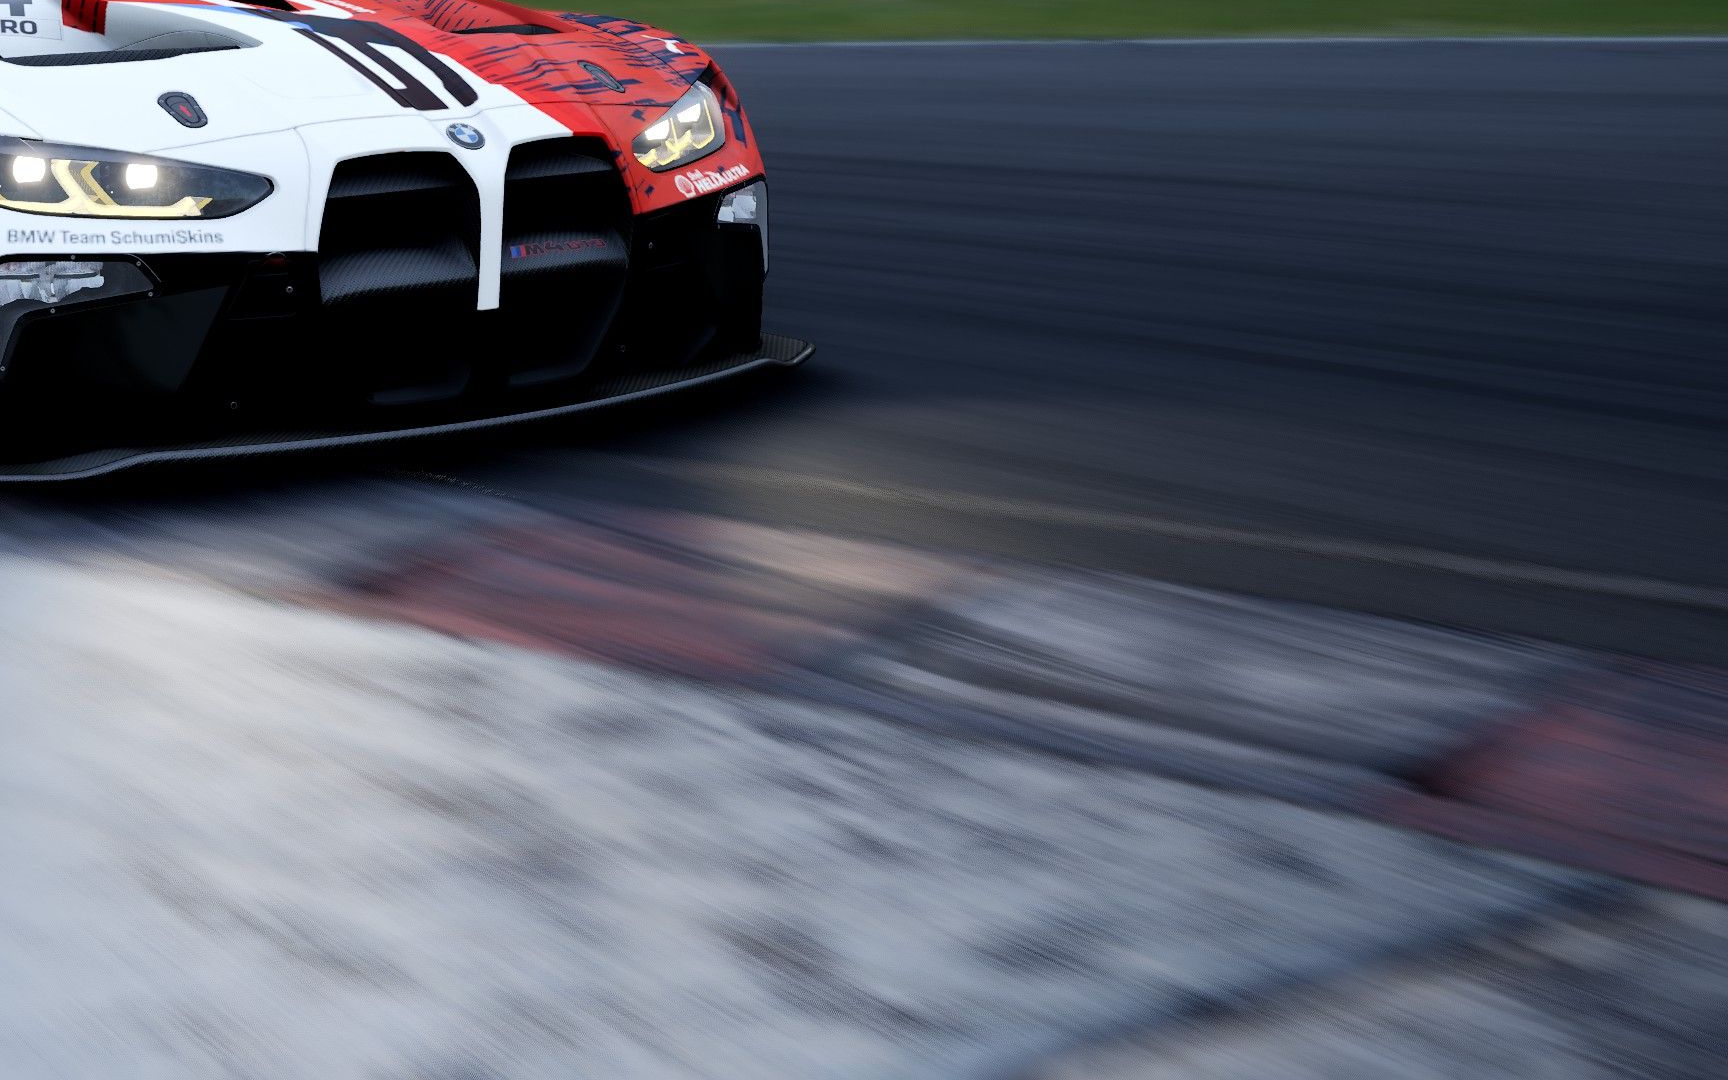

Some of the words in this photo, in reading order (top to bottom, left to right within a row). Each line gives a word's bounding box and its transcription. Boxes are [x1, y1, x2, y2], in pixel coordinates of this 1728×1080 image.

[7, 228, 55, 244] BMW
[60, 228, 106, 245] Team
[110, 228, 225, 245] SchumiSkins
